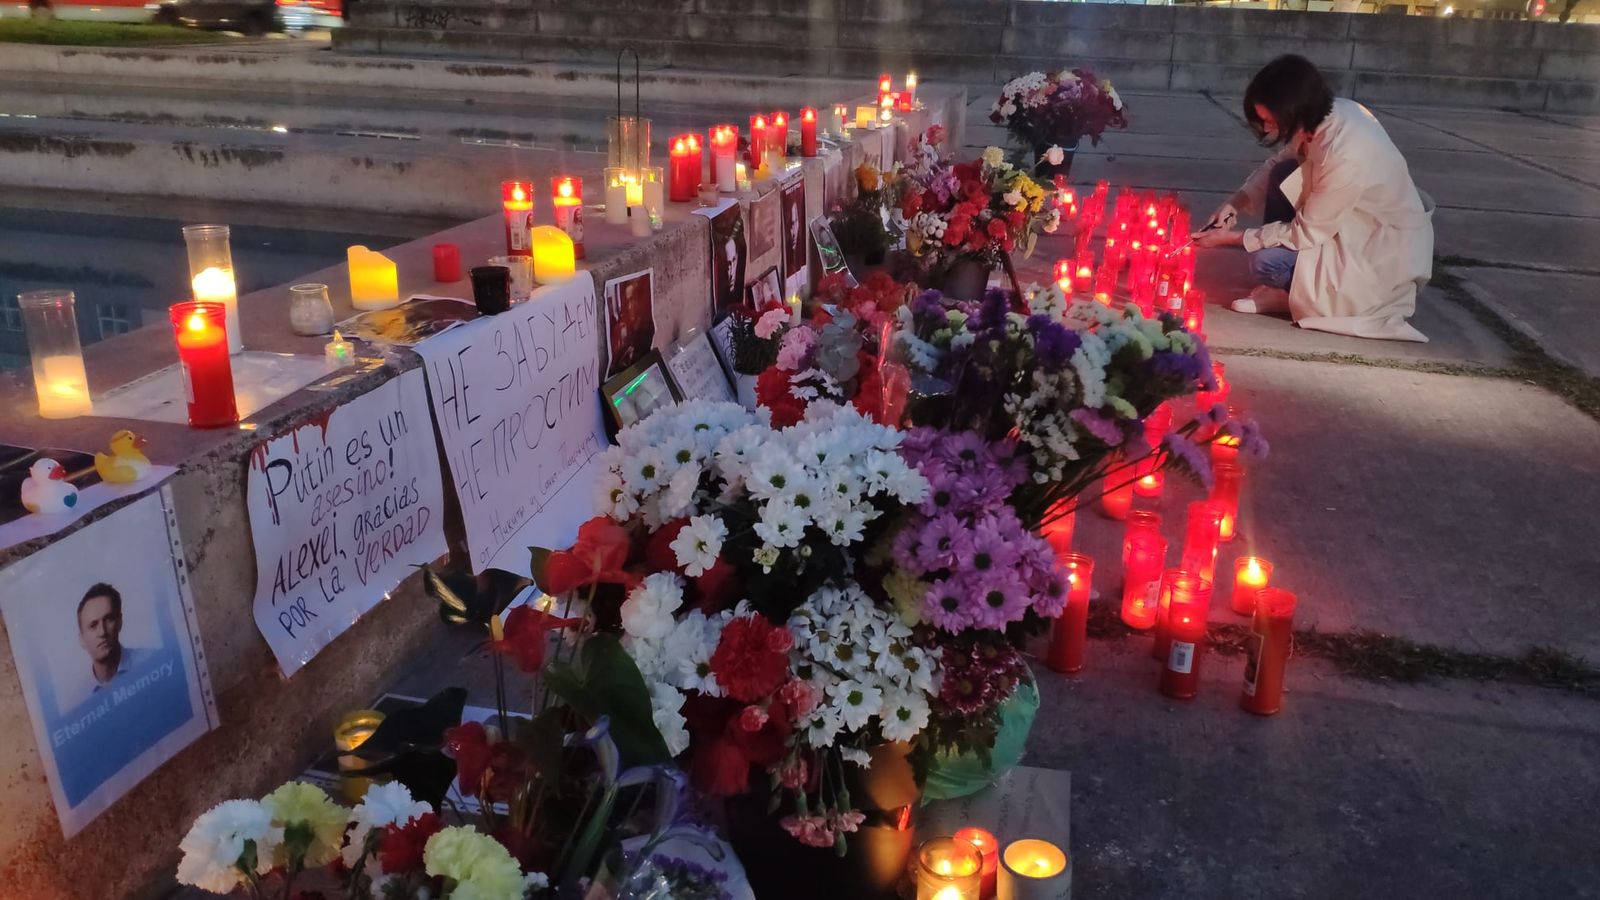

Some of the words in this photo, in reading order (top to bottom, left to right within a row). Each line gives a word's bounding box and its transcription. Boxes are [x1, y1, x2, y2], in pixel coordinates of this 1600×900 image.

[434, 345, 481, 437] НЕ
[494, 296, 595, 391] ЗАБУДЕМ
[264, 446, 335, 526] Putin
[345, 430, 373, 466] es
[378, 409, 408, 447] un
[310, 447, 395, 527] asesino!
[453, 438, 489, 511] НЕ
[491, 358, 596, 477] ПРОСТИМ
[52, 695, 109, 749] Eternal
[112, 658, 175, 710] Memory
